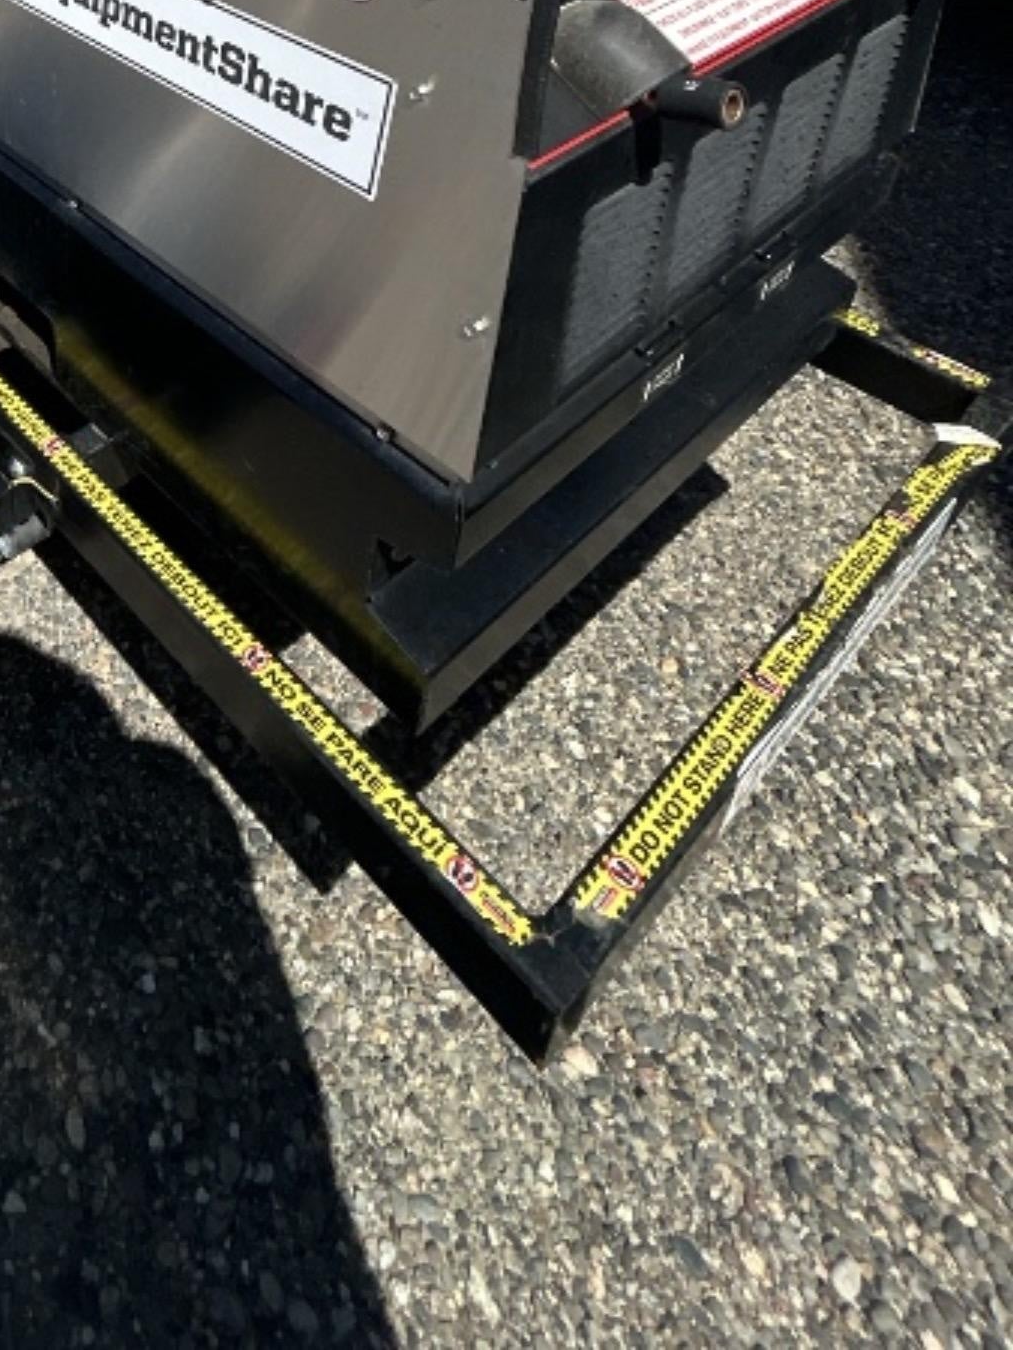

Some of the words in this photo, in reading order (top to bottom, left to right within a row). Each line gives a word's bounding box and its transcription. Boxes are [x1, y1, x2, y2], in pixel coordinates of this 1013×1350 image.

[266, 667, 297, 701] NO
[296, 700, 327, 730] SE
[329, 731, 385, 795] PARE
[629, 830, 660, 863] DO
[653, 789, 690, 836] NOT
[683, 735, 733, 797] STAND
[727, 693, 765, 736] HERE
